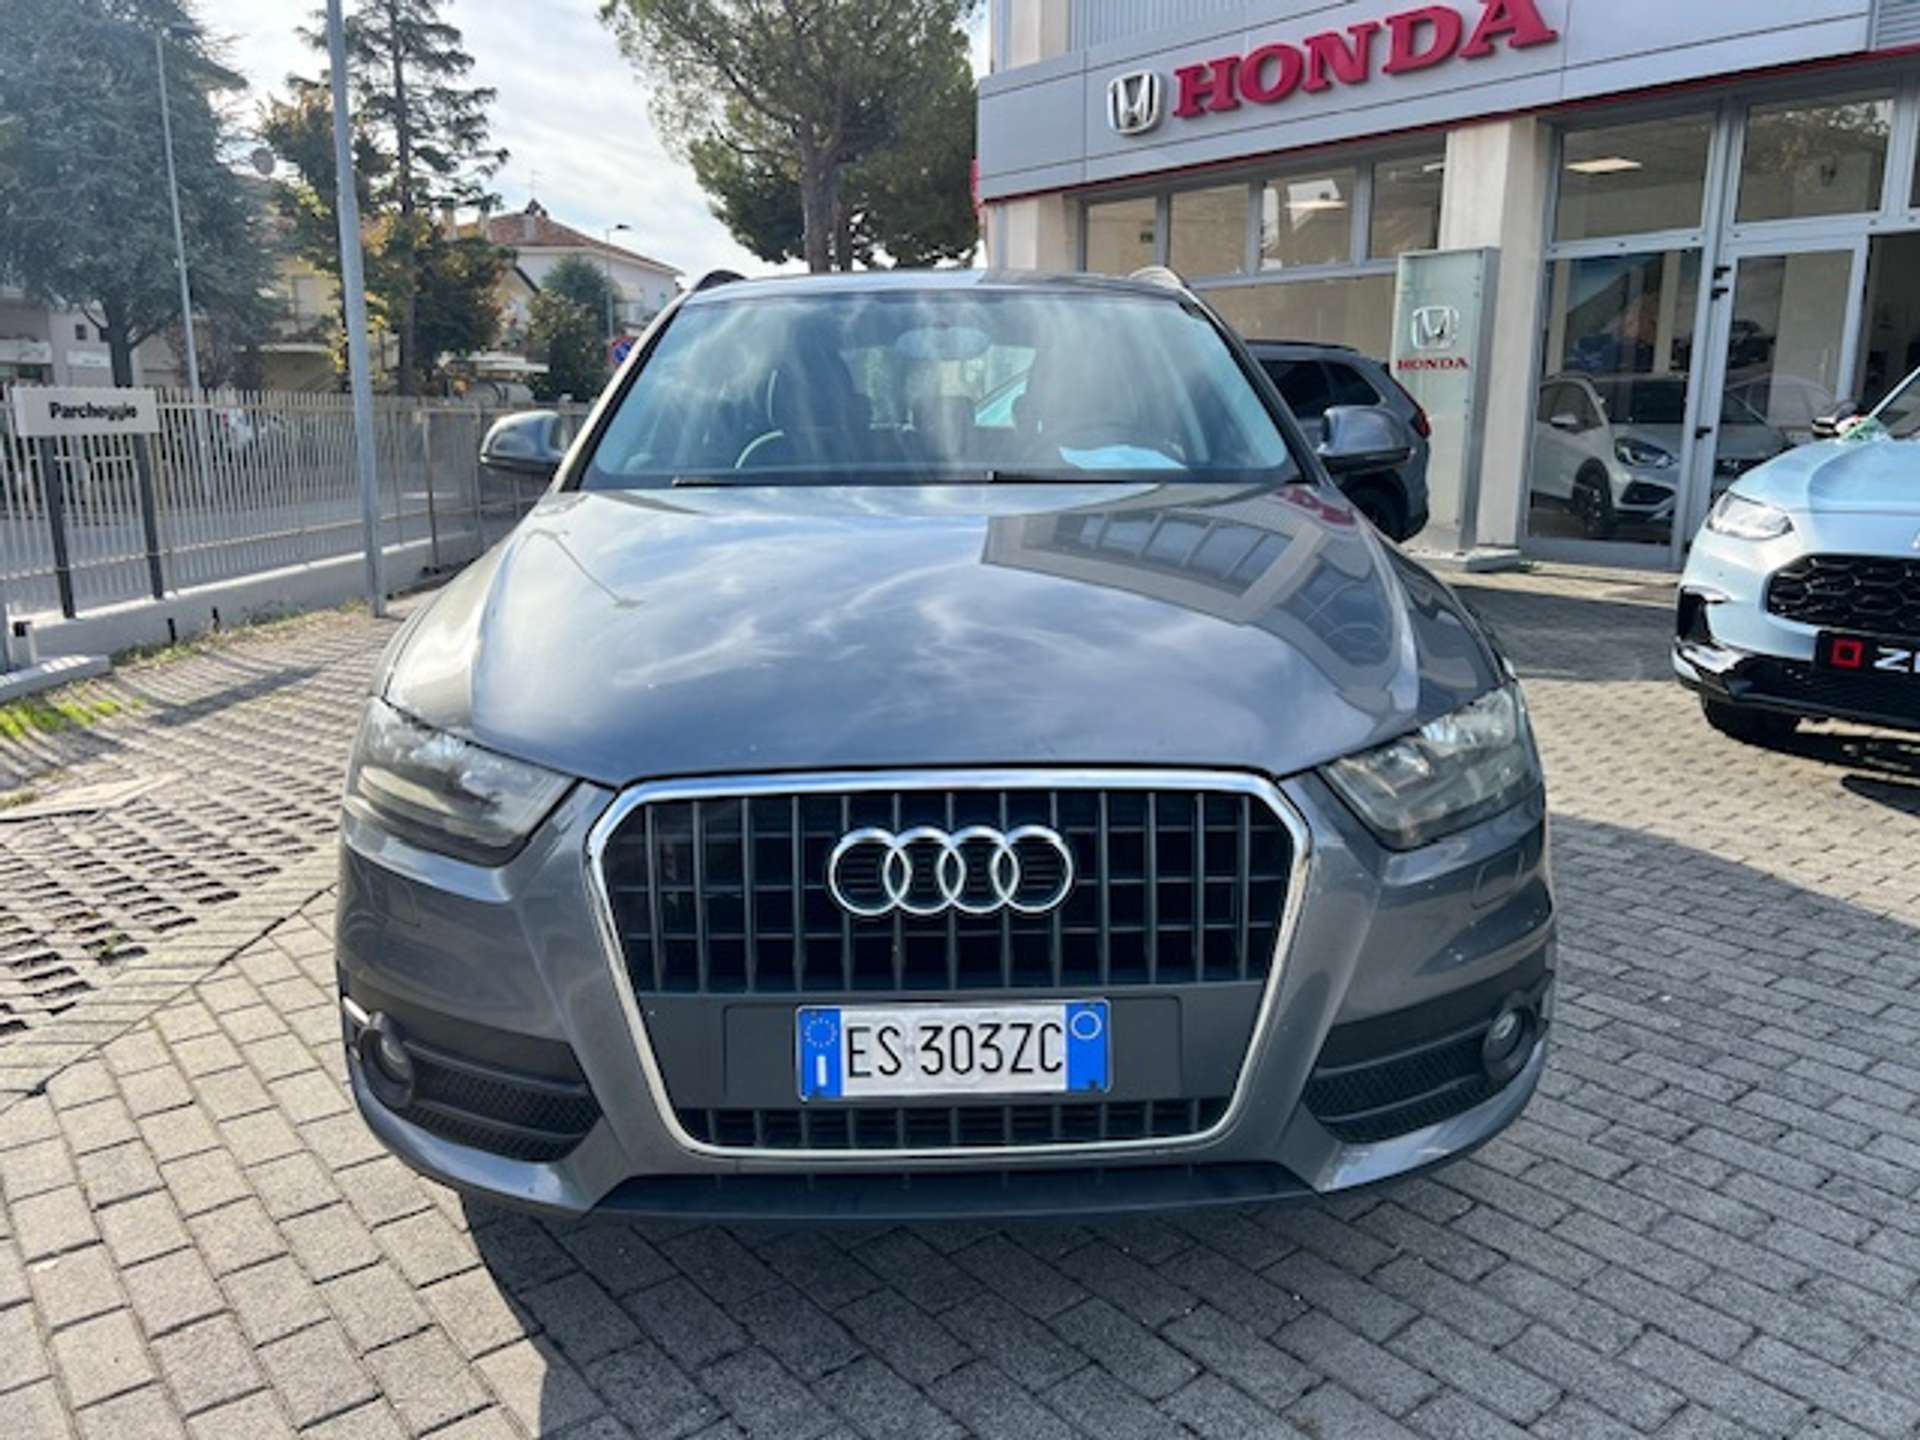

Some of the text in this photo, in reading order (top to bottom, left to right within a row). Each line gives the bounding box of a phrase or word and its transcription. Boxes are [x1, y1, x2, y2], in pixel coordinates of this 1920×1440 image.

[1173, 0, 1558, 118] HONDA
[1397, 356, 1469, 371] HONDA
[49, 401, 137, 421] Parcheggio
[847, 1022, 1063, 1078] ES 303ZC
